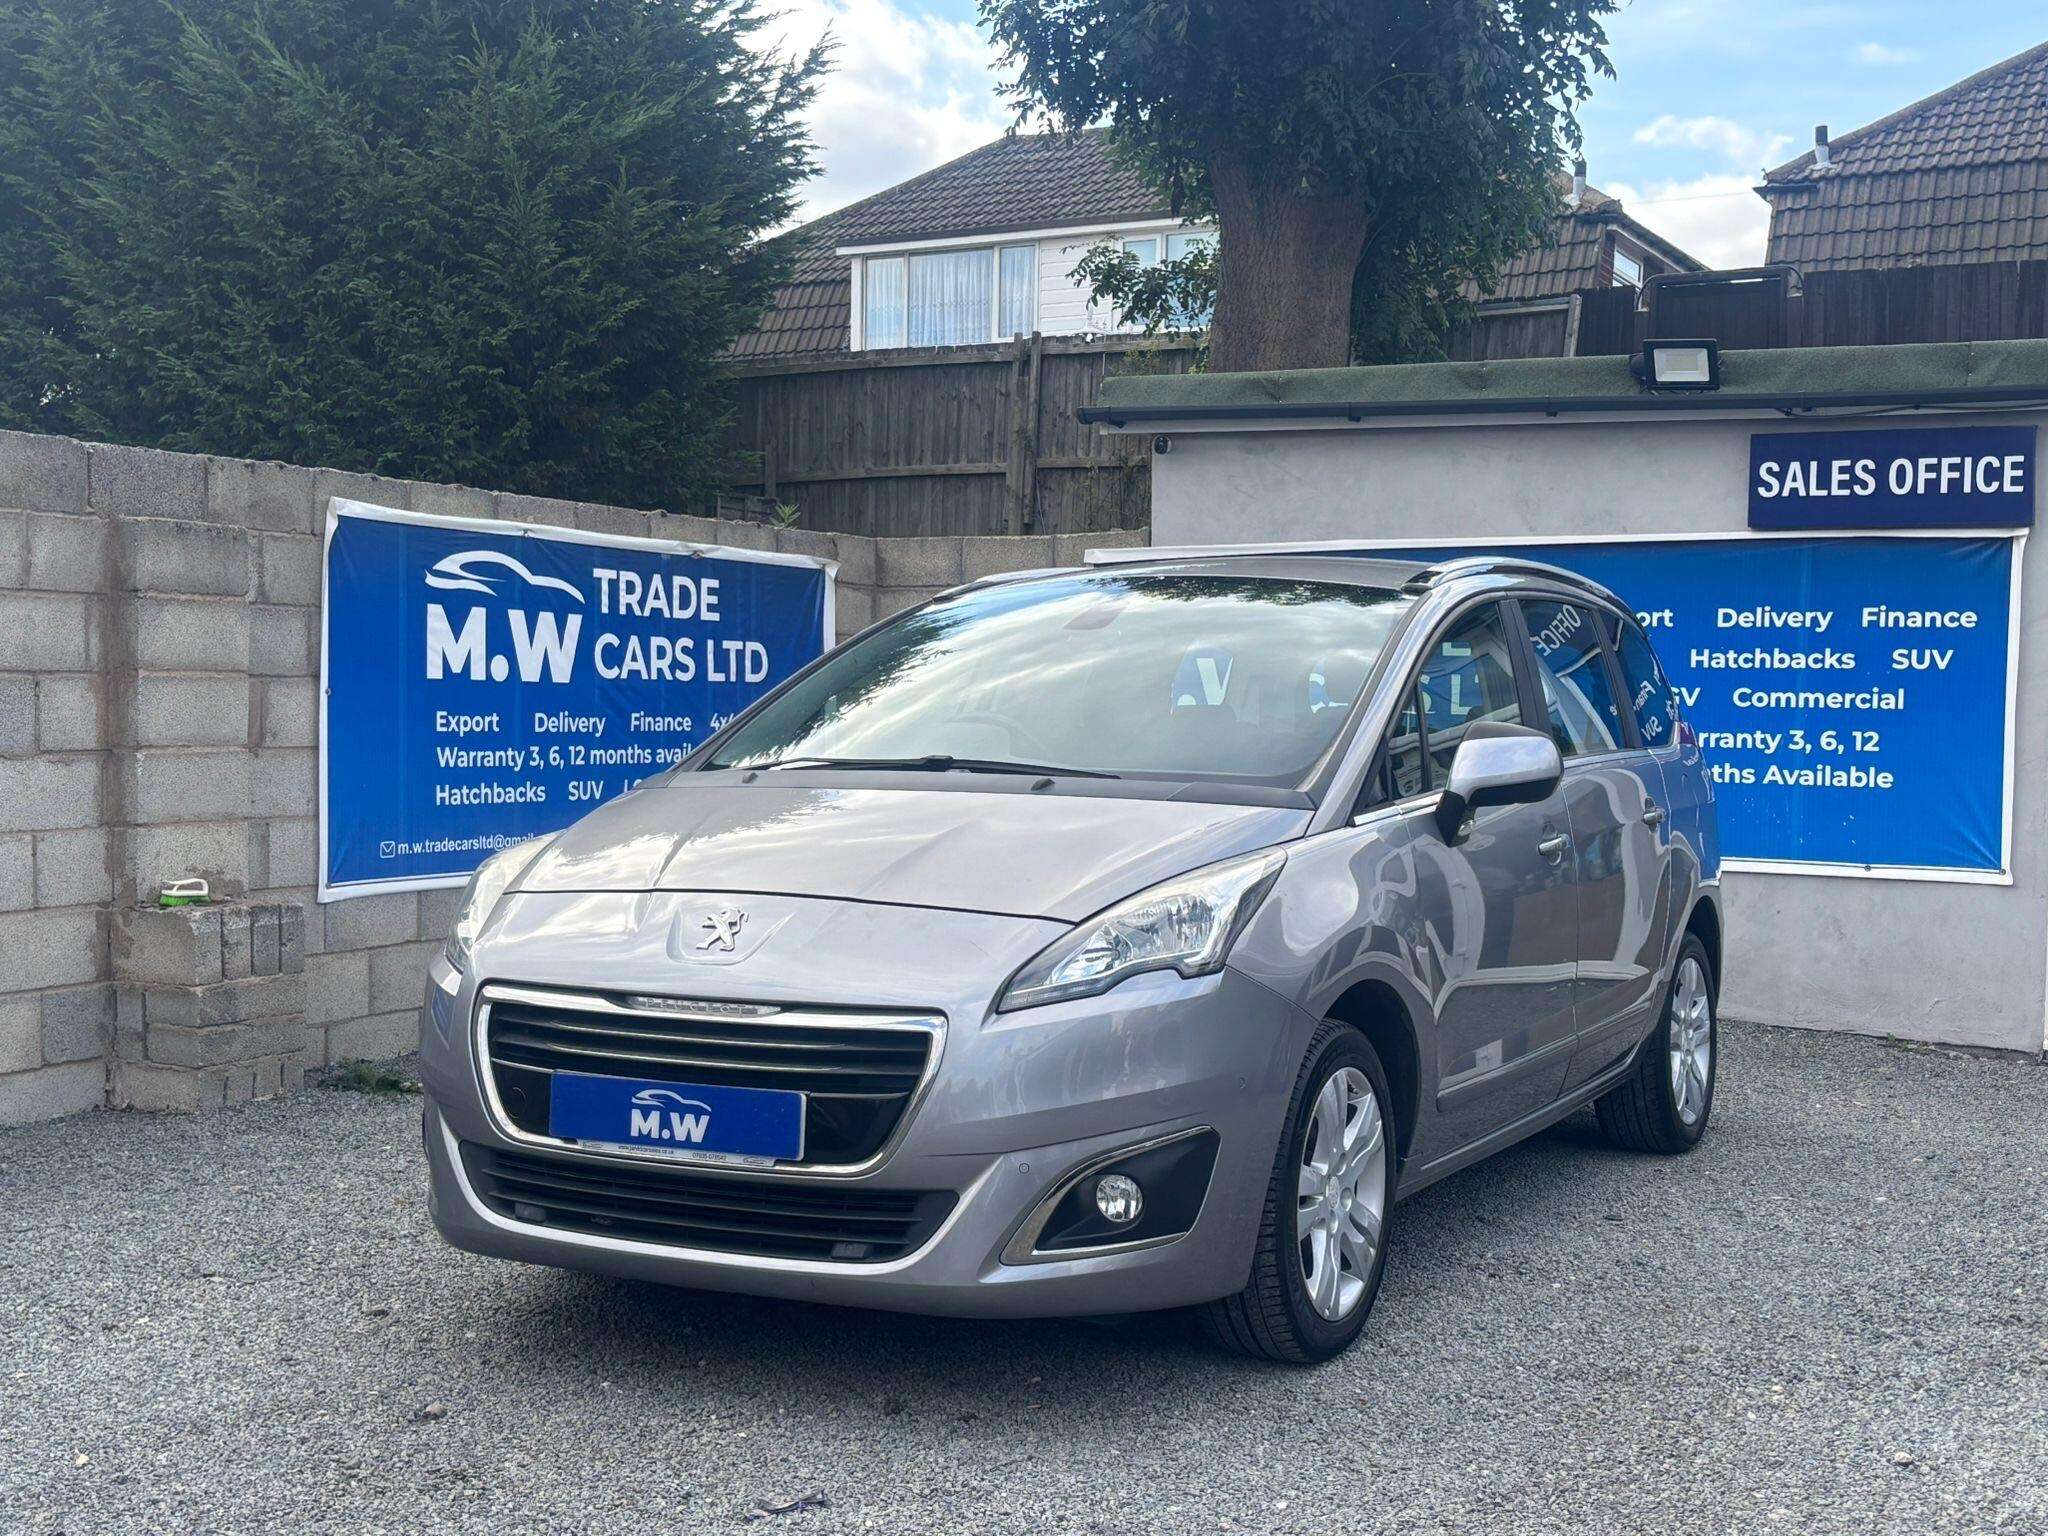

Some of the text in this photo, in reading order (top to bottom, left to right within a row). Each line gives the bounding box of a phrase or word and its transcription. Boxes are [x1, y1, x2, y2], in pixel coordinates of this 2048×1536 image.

[1757, 455, 2025, 498] SALES OFFICE
[593, 568, 721, 622] TRADE
[1717, 606, 1834, 633] Delivery
[1861, 605, 1978, 629] Finance
[426, 603, 583, 683] M.W
[594, 632, 769, 683] CARS LTD
[1690, 648, 1954, 671] Hatchbacks SUV
[1732, 687, 1905, 711] Commercial
[436, 711, 500, 737] Export
[534, 711, 606, 738] Delivery
[630, 711, 692, 732] Finance
[1788, 730, 1812, 754] 3,
[1820, 731, 1845, 755] 6,
[1852, 732, 1880, 752] 12
[436, 747, 525, 771] Warranty
[529, 746, 544, 770] 3,
[549, 746, 565, 770] 6,
[568, 746, 586, 765] 12
[589, 744, 653, 765] months
[1707, 763, 1894, 788] ths Available
[435, 781, 546, 806] Hatchbacks
[568, 780, 603, 801] SUV
[630, 1109, 710, 1143] M.W
